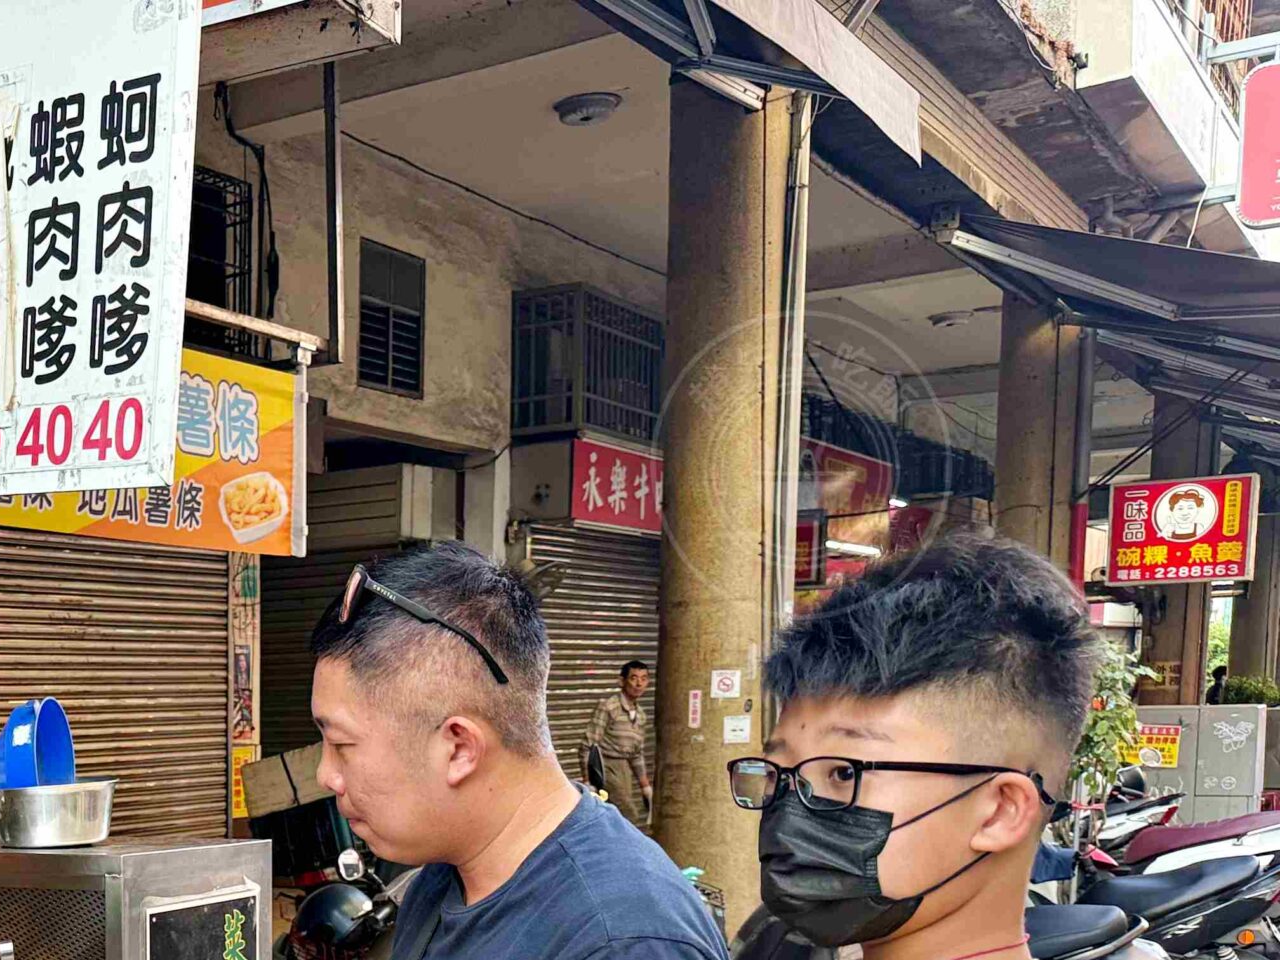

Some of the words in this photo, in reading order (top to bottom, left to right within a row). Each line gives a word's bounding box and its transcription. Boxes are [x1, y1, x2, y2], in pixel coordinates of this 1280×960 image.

[16, 404, 73, 466] 40
[82, 397, 143, 461] 40
[581, 451, 662, 522] 永樂牛
[1123, 489, 1150, 542] 一味品
[1154, 564, 1239, 579] 2288563
